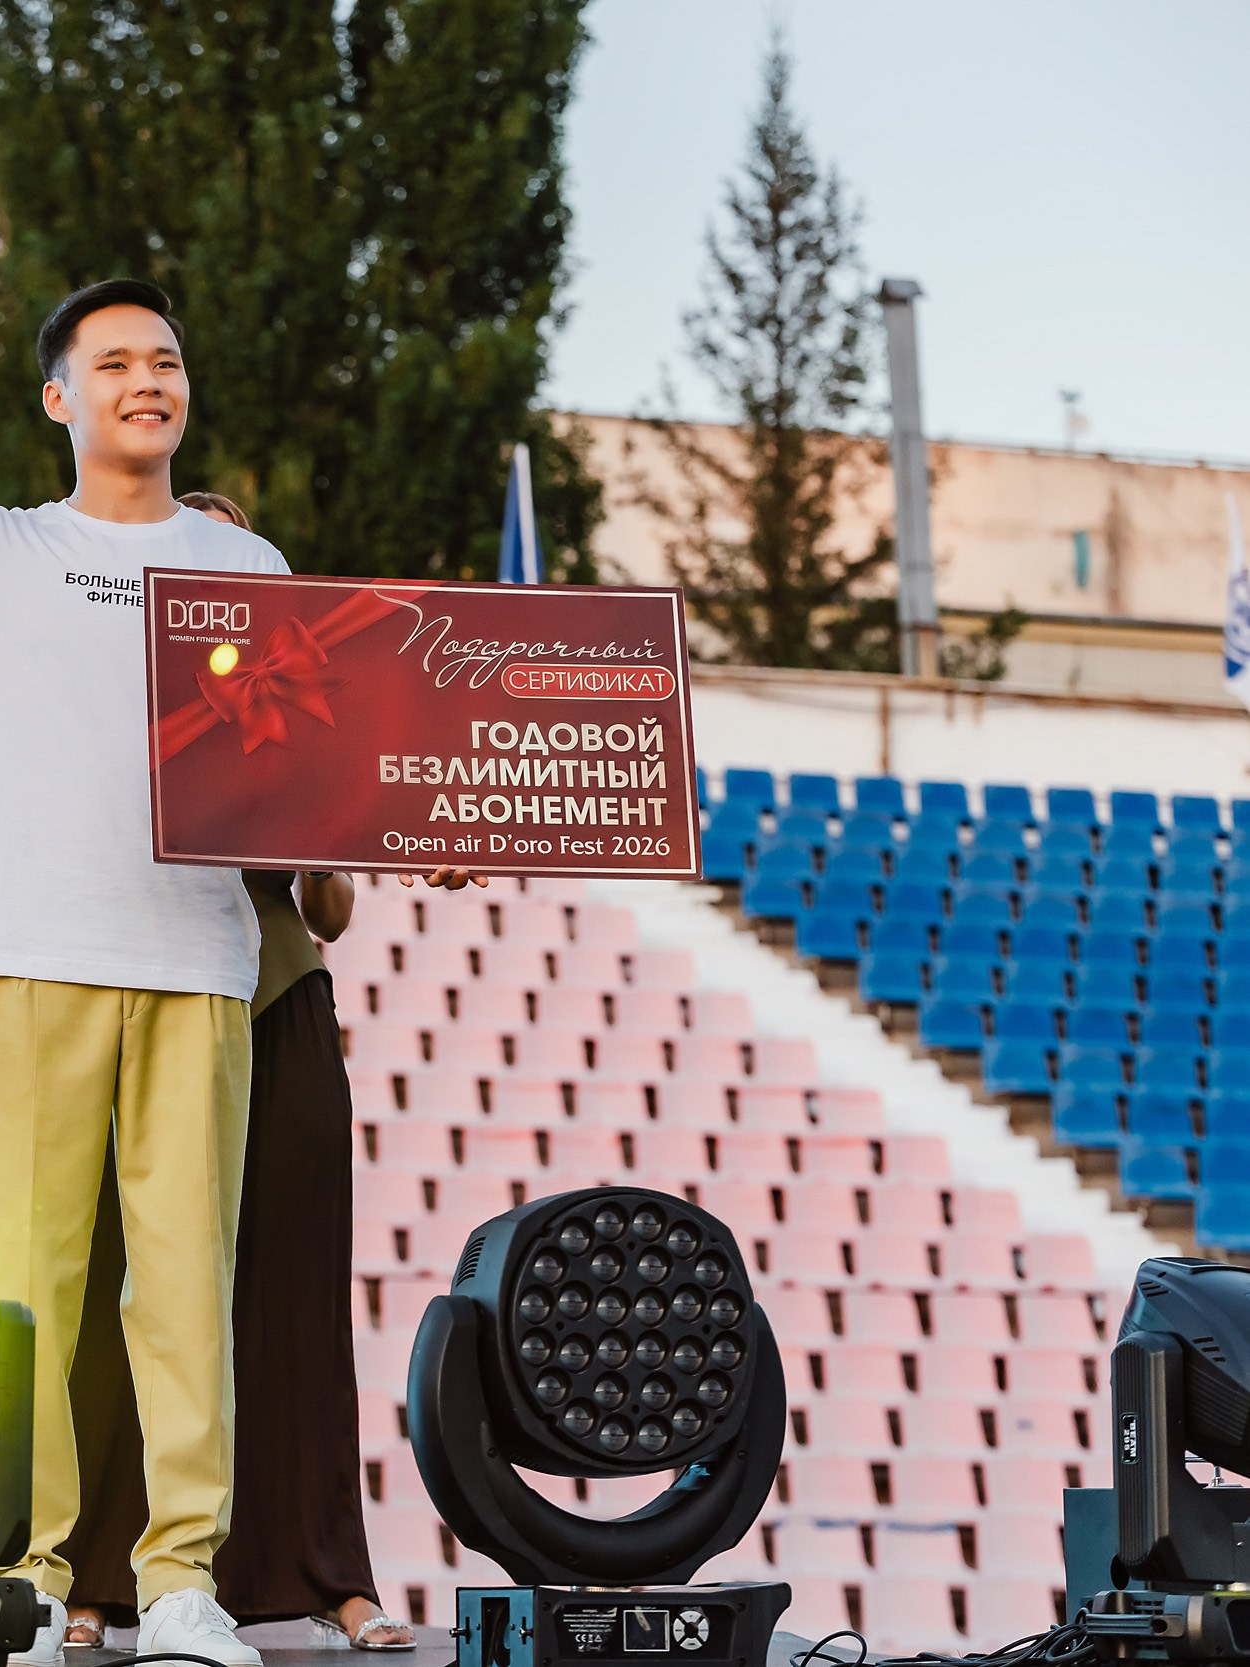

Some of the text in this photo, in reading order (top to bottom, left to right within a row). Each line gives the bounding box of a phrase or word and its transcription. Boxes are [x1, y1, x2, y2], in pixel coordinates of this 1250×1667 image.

[64, 572, 142, 592] БОЛЬШЕ
[86, 590, 144, 608] ФИТНЕ
[168, 634, 195, 642] WOMEN
[196, 636, 224, 644] FITNESS
[373, 589, 664, 689] Подарочный
[509, 670, 666, 693] СЕРТИФИКАТ
[471, 717, 664, 755] ГОДОВОЙ
[378, 753, 667, 789] БЕЗЛИМИТНЫЙ
[428, 793, 667, 826] АБОНЕМЕНТ
[382, 831, 447, 856] Open
[453, 834, 482, 853] air
[560, 835, 604, 855] Fest
[611, 836, 670, 856] 2026
[575, 1634, 587, 1643] CE
